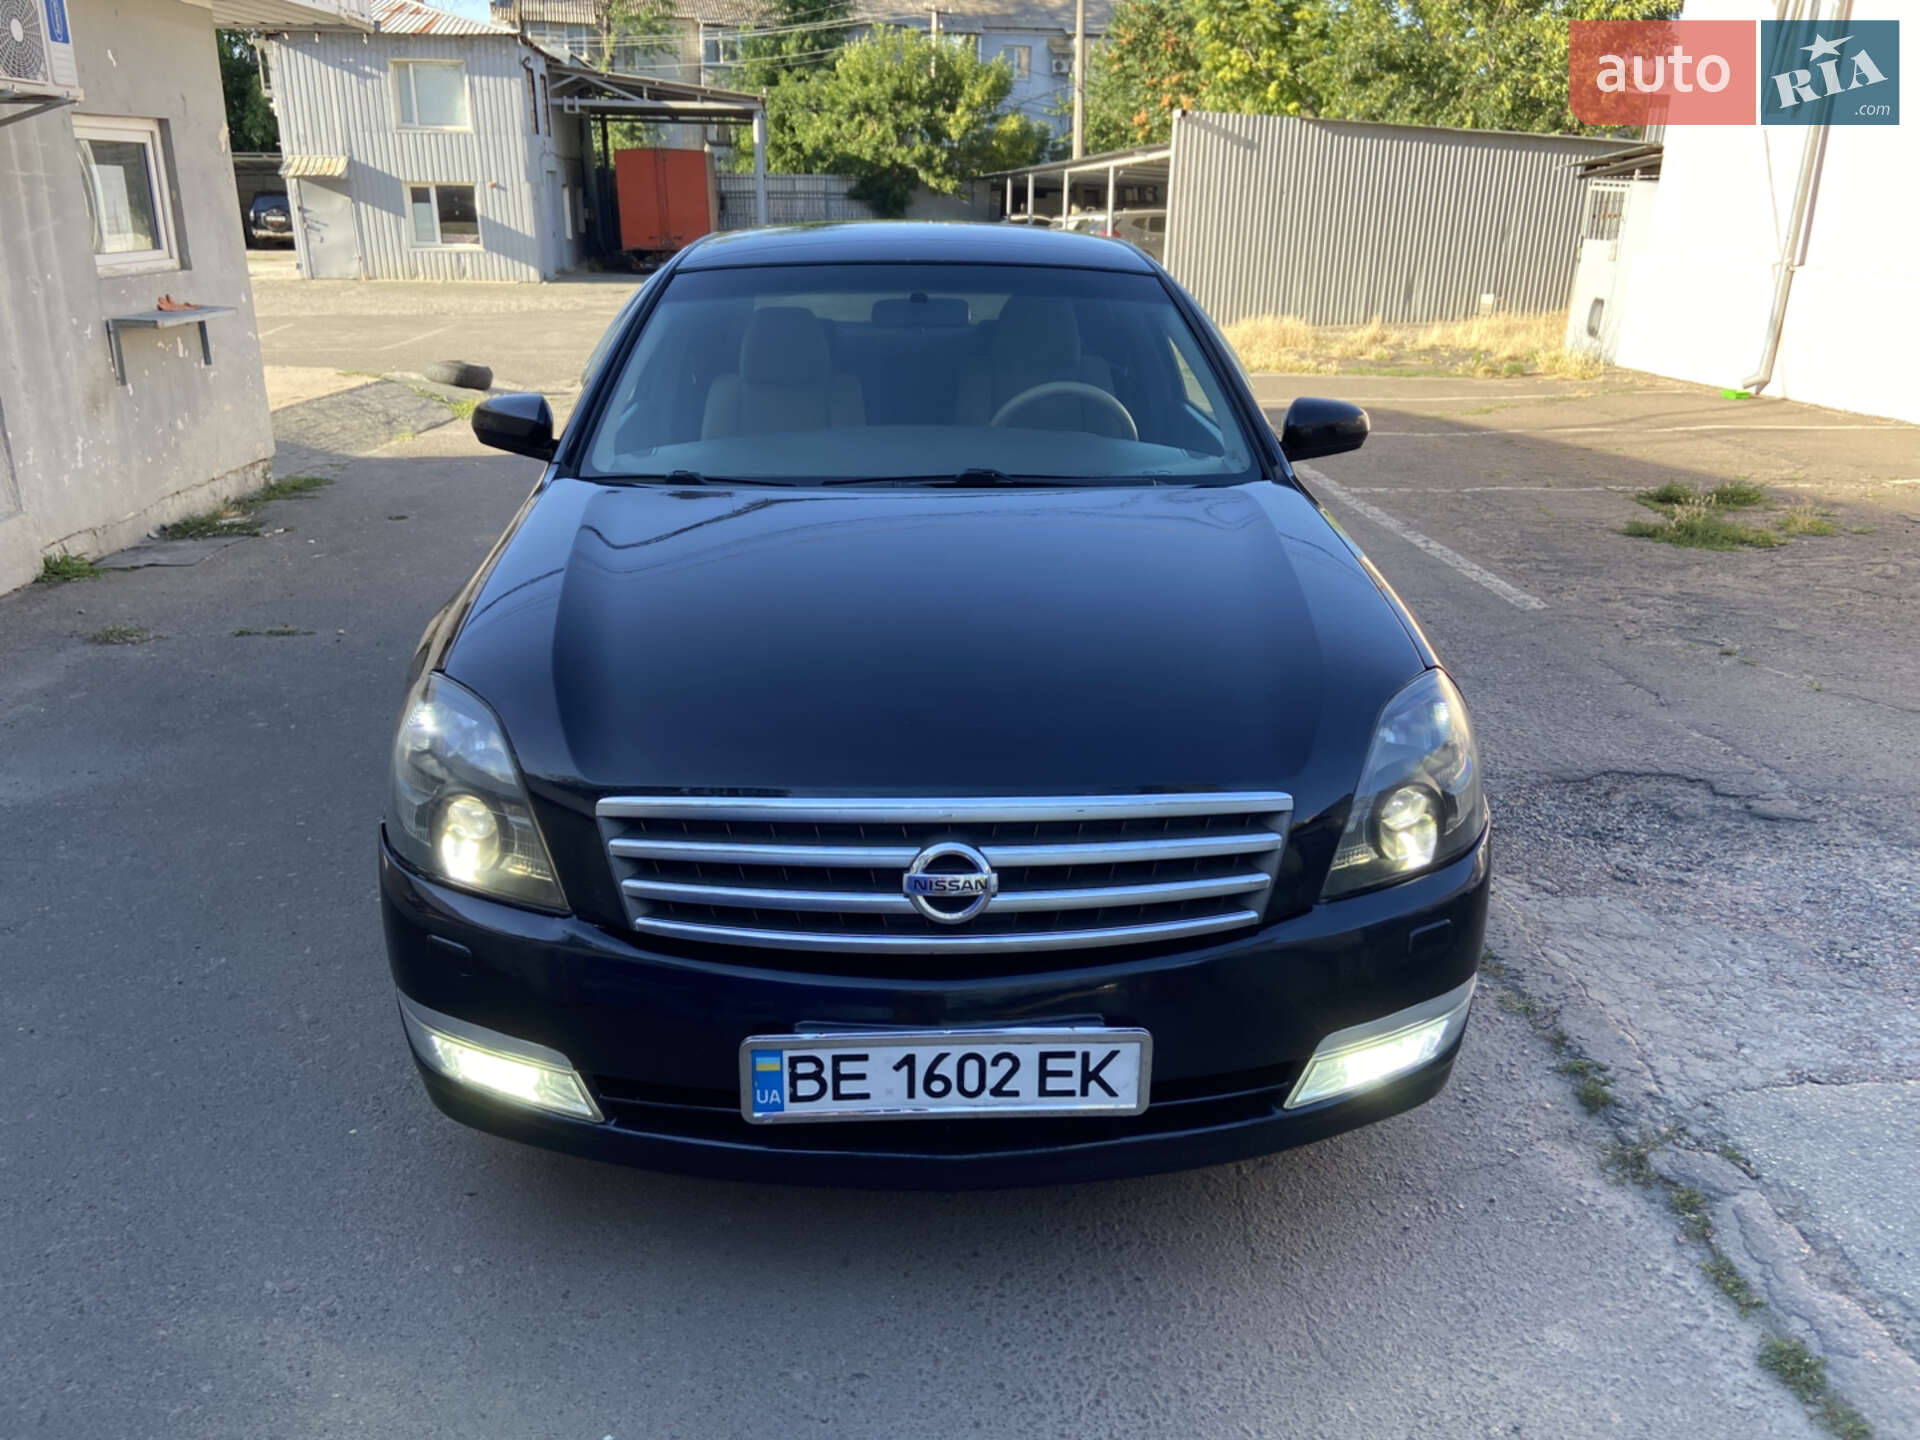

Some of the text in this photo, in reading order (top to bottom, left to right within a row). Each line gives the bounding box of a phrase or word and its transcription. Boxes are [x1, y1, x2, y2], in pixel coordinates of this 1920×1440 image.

[913, 879, 988, 892] NISSAN
[788, 1050, 1121, 1103] BE 1602 EK
[756, 1089, 782, 1105] UA
